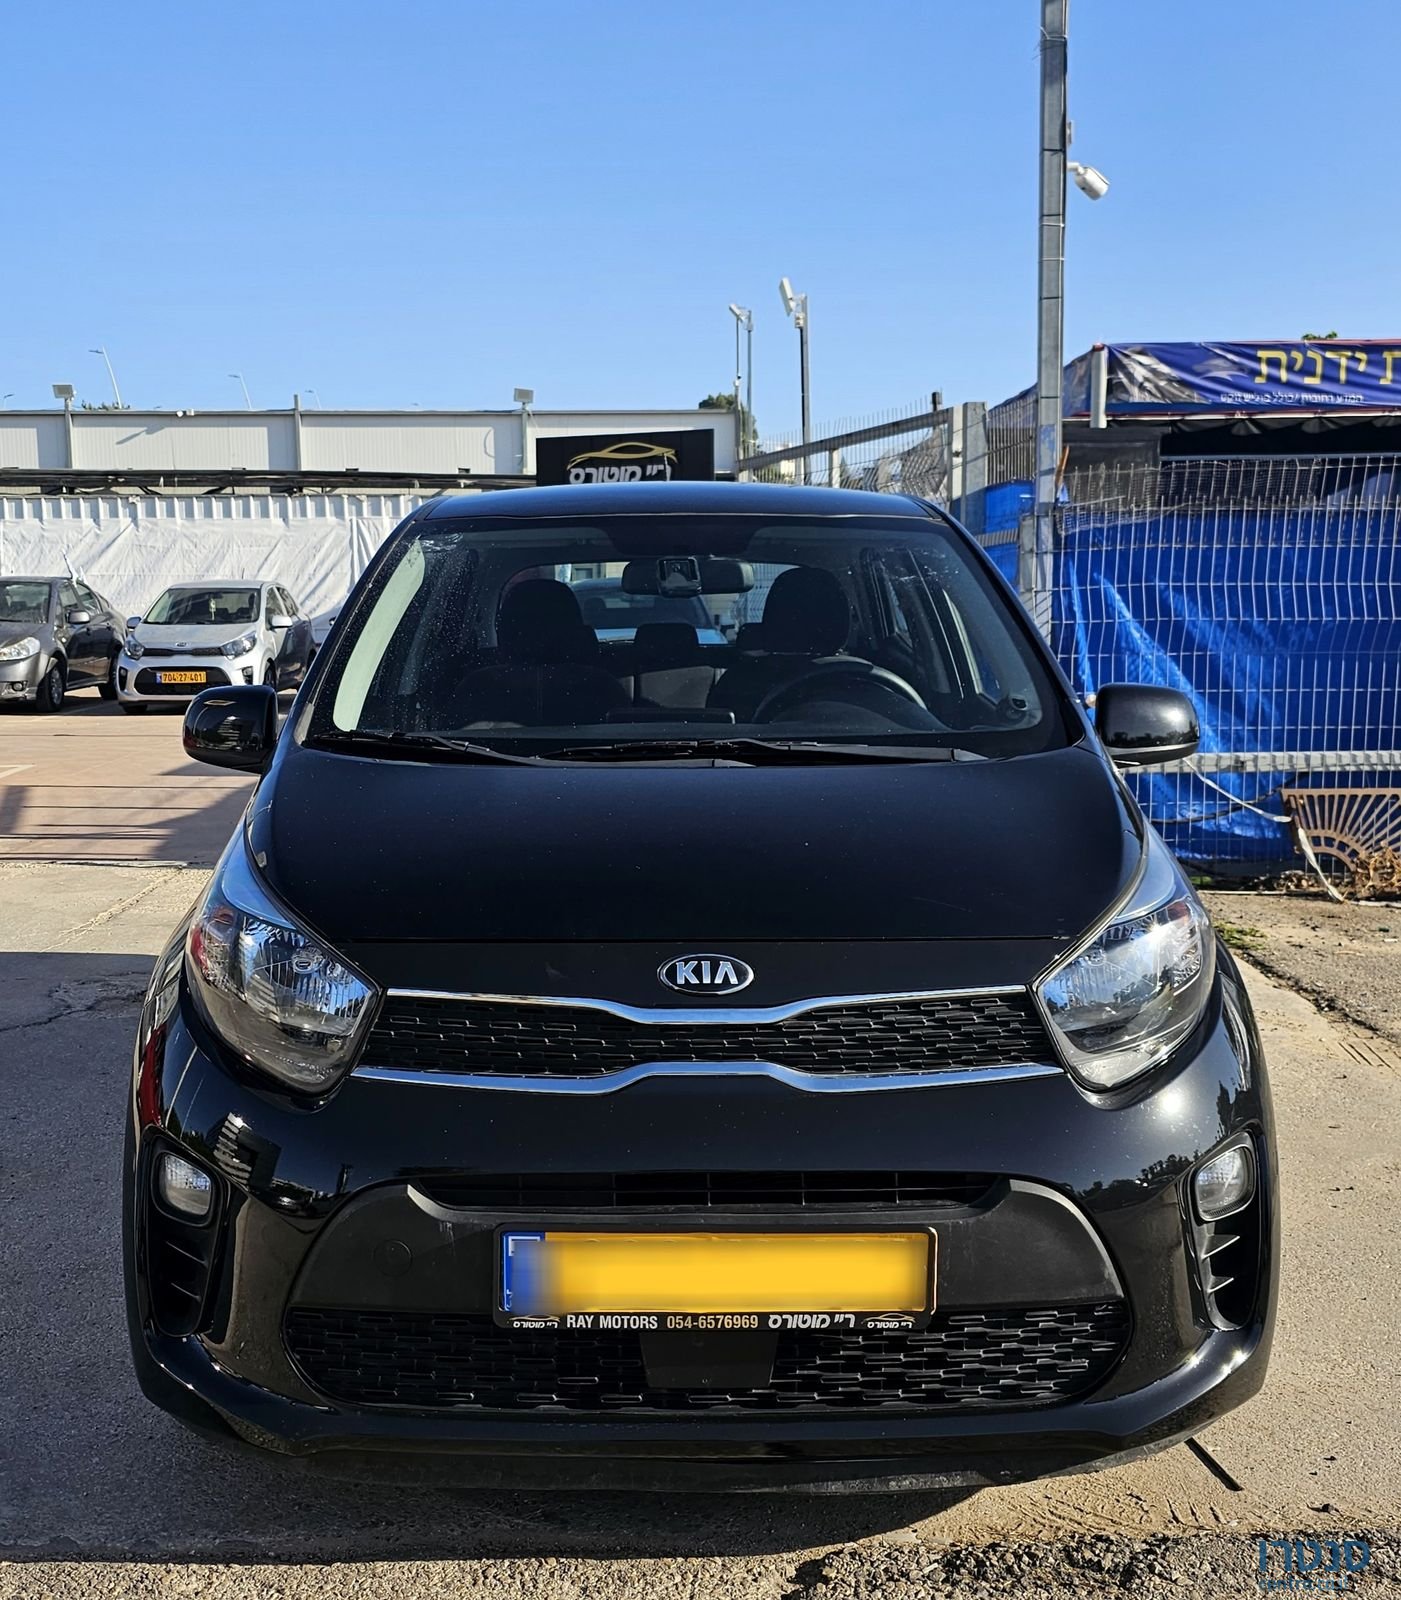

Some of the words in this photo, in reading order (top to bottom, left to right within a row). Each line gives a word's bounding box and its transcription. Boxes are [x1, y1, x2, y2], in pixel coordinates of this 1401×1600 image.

[1254, 350, 1368, 384] ידנית
[569, 465, 642, 484] מוטורס
[676, 960, 739, 985] KIA
[513, 1321, 546, 1329] מוטורס
[566, 1315, 595, 1328] RAY
[600, 1315, 658, 1329] MOTORS
[666, 1314, 759, 1329] 054-6576969
[767, 1314, 831, 1329] מוטורס
[867, 1321, 900, 1329] מוטורס
